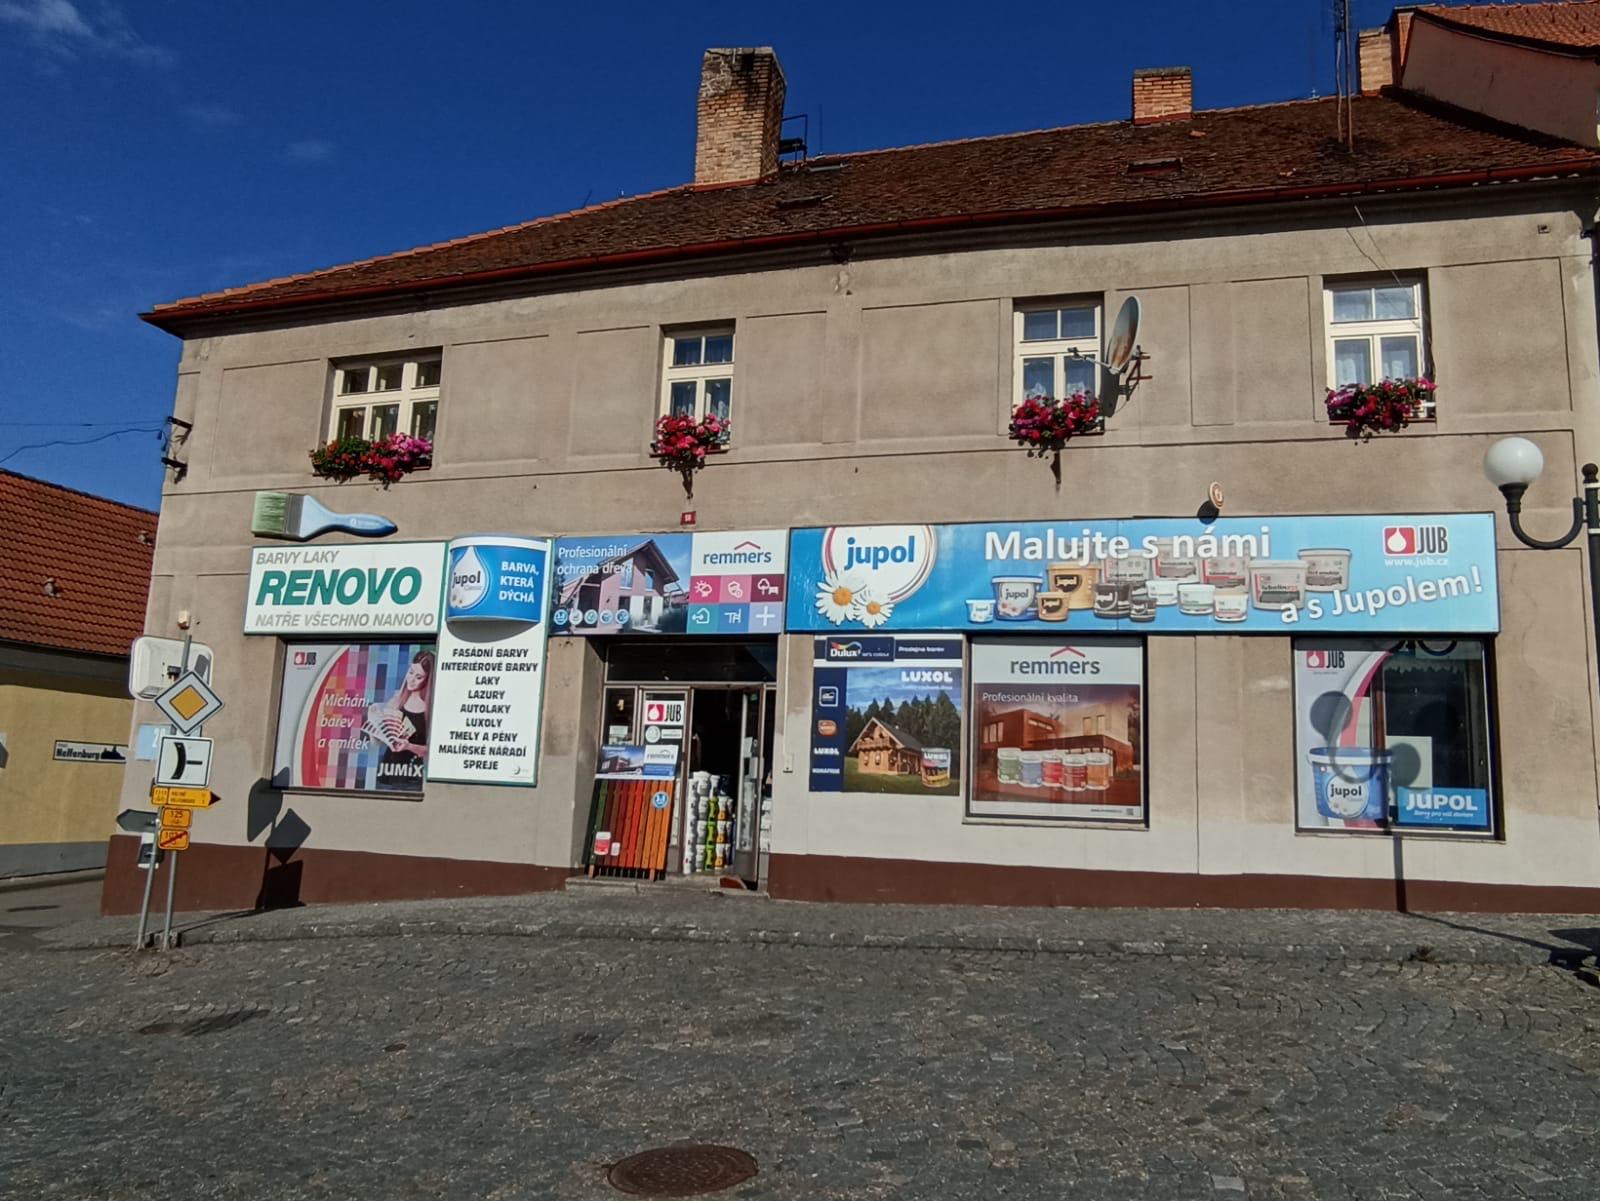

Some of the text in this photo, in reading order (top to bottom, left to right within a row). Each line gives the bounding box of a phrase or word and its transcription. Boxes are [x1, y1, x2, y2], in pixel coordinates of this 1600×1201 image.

[985, 525, 1271, 566] Malujte s námi
[1416, 526, 1448, 554] JUB
[256, 550, 340, 565] BARVY LAKY
[558, 543, 628, 559] Profesionální
[703, 549, 772, 565] remmers
[844, 535, 916, 571] jupol
[501, 560, 539, 576] BARVA,
[556, 562, 633, 576] ochrana dřeva
[1383, 556, 1449, 568] www.jub.cz
[255, 566, 422, 605] RENOVO
[452, 570, 481, 588] jupol
[500, 574, 534, 589] KTERÁ
[499, 589, 535, 603] DÝCHÁ
[1004, 588, 1030, 600] jupol
[1281, 566, 1483, 624] a s Jupolem!
[255, 610, 435, 627] NATŘE VŠECHNO NANOVO
[452, 646, 529, 658] FASÁDNÍ BARVY
[830, 648, 858, 657] Dulux
[441, 661, 539, 672] INTERIÉROVÉ BARVY
[1326, 650, 1345, 669] JUB
[1010, 660, 1100, 675] remmers
[475, 676, 501, 685] LAKY
[901, 671, 953, 683] LUXOL
[468, 690, 505, 700] LAZURY
[982, 692, 1079, 703] Profesionální kvalita
[460, 704, 511, 714] AUTOLAKY
[664, 703, 682, 722] JUB
[320, 714, 355, 728] barev
[466, 718, 503, 728] LUXOLY
[317, 737, 326, 748] a
[449, 731, 518, 742] TMELY A PĚNY
[438, 743, 527, 757] MALÍŘSKÉ NÁŘADÍ
[463, 759, 499, 770] SPREJE
[1330, 784, 1363, 798] jupol
[1406, 792, 1478, 812] JUPOL
